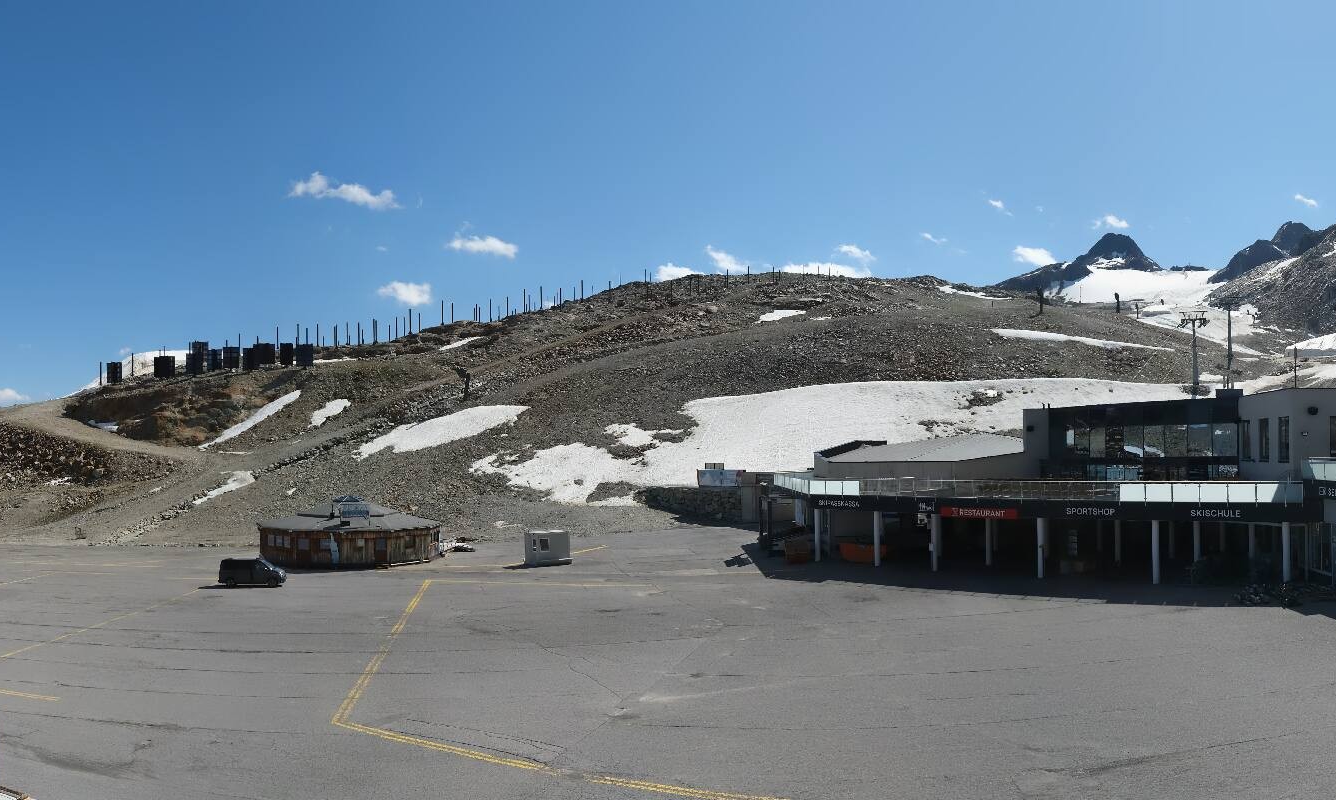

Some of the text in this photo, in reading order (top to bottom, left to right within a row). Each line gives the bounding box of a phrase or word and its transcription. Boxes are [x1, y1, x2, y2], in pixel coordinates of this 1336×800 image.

[959, 508, 1005, 517] RESTAURANT
[1066, 507, 1116, 516] SPORTSHOP
[1190, 509, 1241, 518] SKISCHULE
